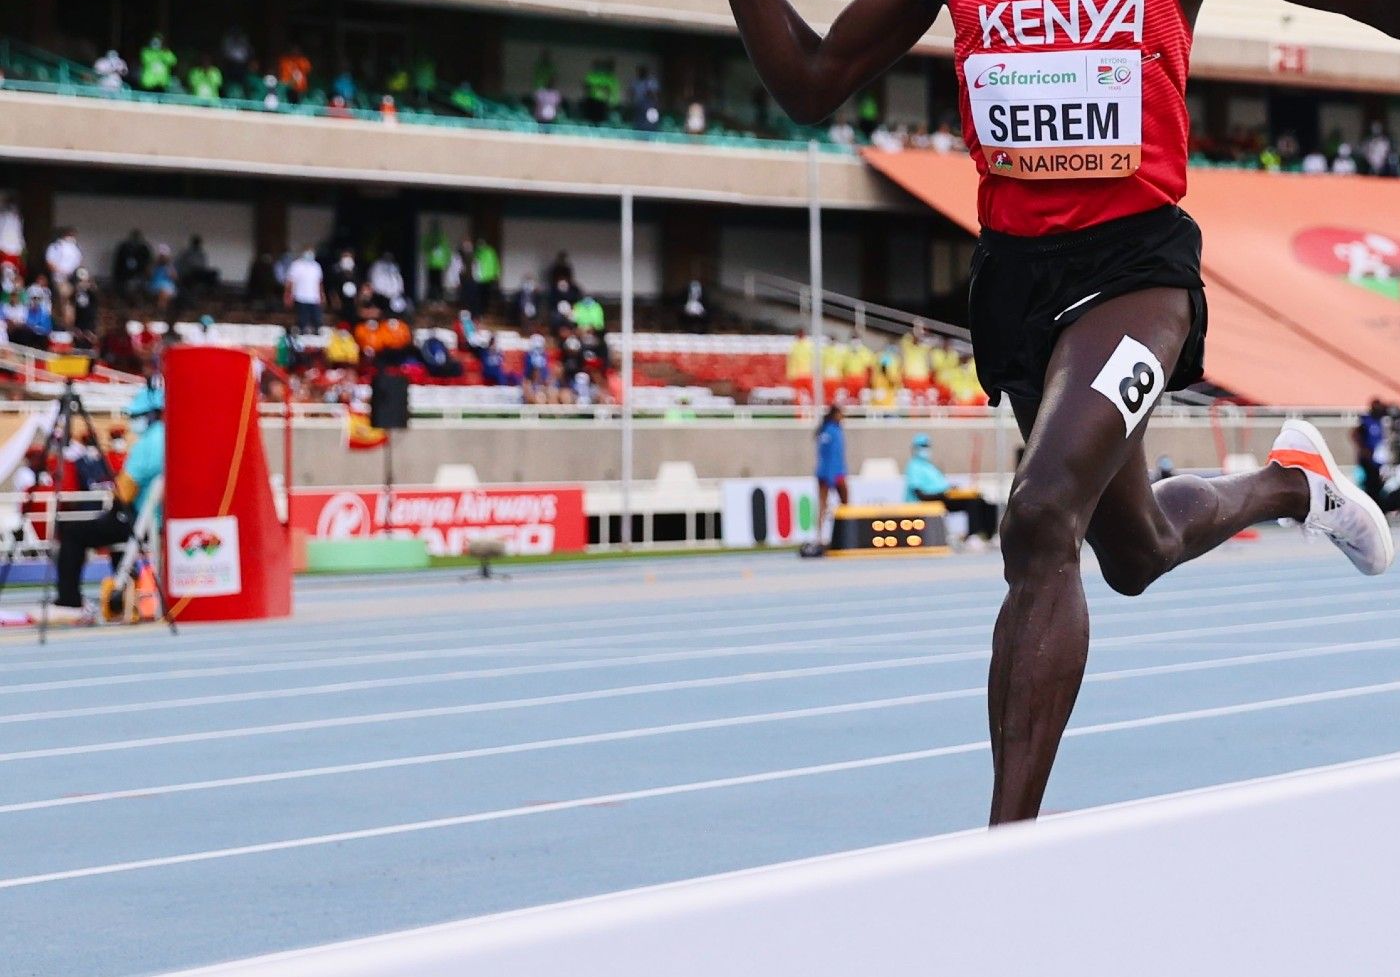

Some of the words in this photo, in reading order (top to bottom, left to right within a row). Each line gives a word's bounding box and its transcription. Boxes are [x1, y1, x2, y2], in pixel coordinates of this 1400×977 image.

[988, 70, 1077, 86] Safaricom
[988, 102, 1119, 142] SEREM
[1019, 154, 1103, 172] NAIROBI
[1110, 153, 1131, 170] 21
[1119, 362, 1154, 414] 8
[374, 490, 456, 524] Kenya
[456, 489, 557, 524] Airways
